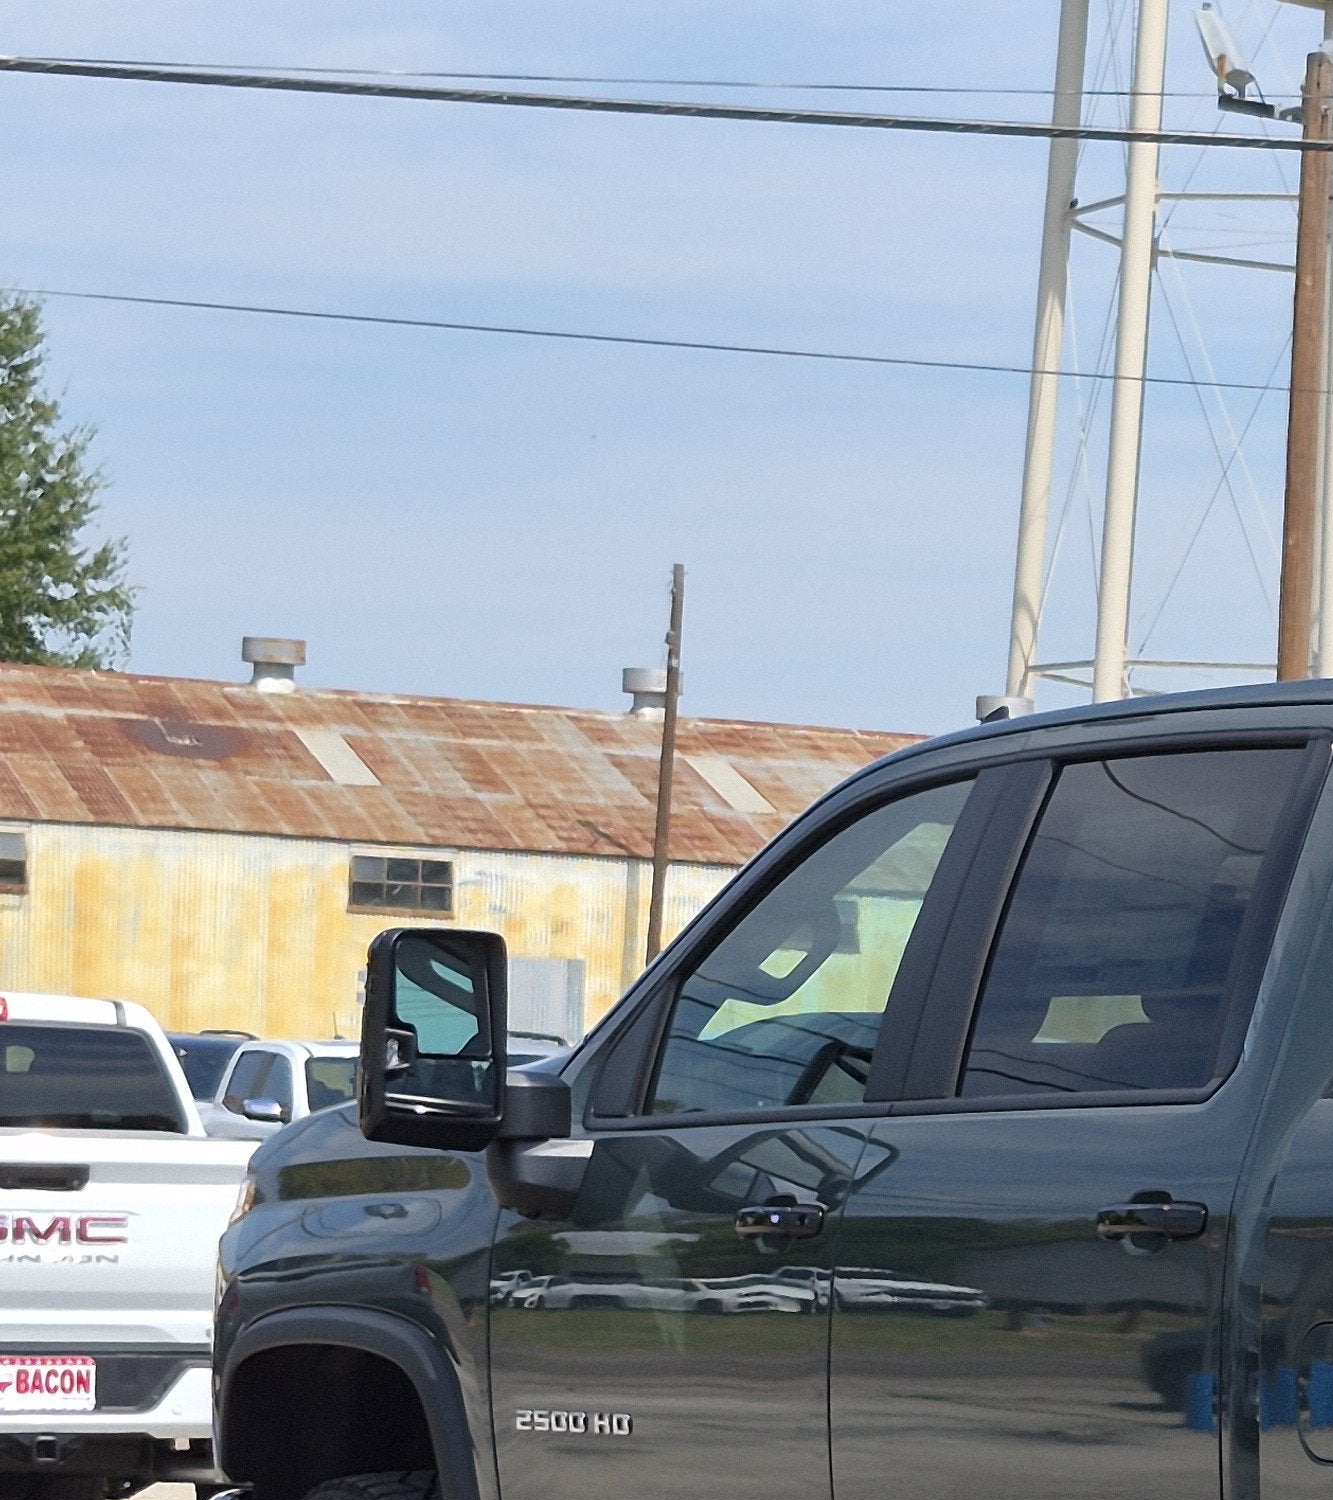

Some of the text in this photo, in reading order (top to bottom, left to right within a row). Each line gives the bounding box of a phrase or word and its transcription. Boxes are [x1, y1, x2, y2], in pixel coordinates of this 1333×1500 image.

[0, 1214, 128, 1245] MC
[15, 1368, 91, 1394] BACON
[515, 1409, 632, 1435] 2500 HD
